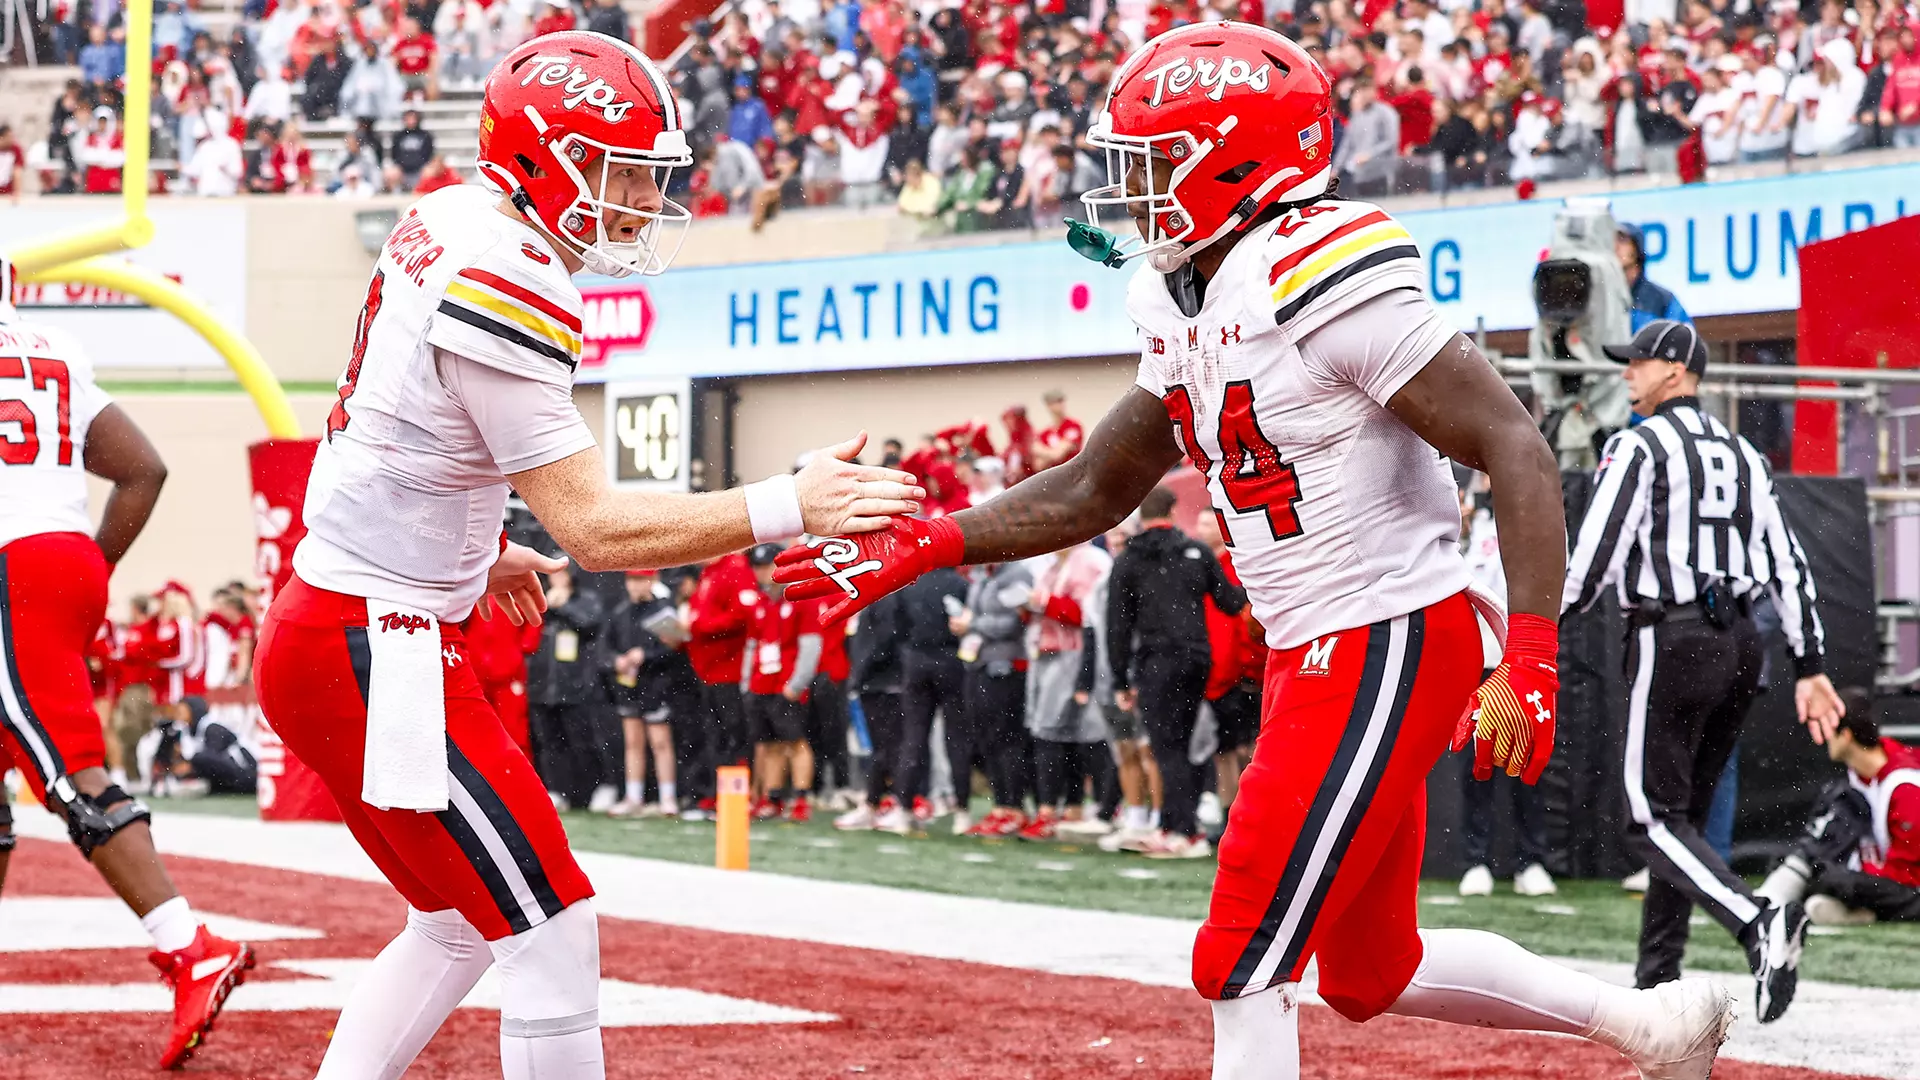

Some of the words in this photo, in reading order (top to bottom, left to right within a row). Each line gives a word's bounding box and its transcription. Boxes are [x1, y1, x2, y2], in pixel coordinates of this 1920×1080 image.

[520, 55, 634, 123] Terps
[1144, 56, 1272, 109] Terps
[1640, 198, 1905, 284] PLUM
[729, 275, 999, 347] HEATING
[0, 356, 73, 467] 57
[616, 395, 679, 480] 40
[1694, 439, 1739, 519] B
[377, 611, 431, 635] Terps
[1300, 636, 1340, 670] M
